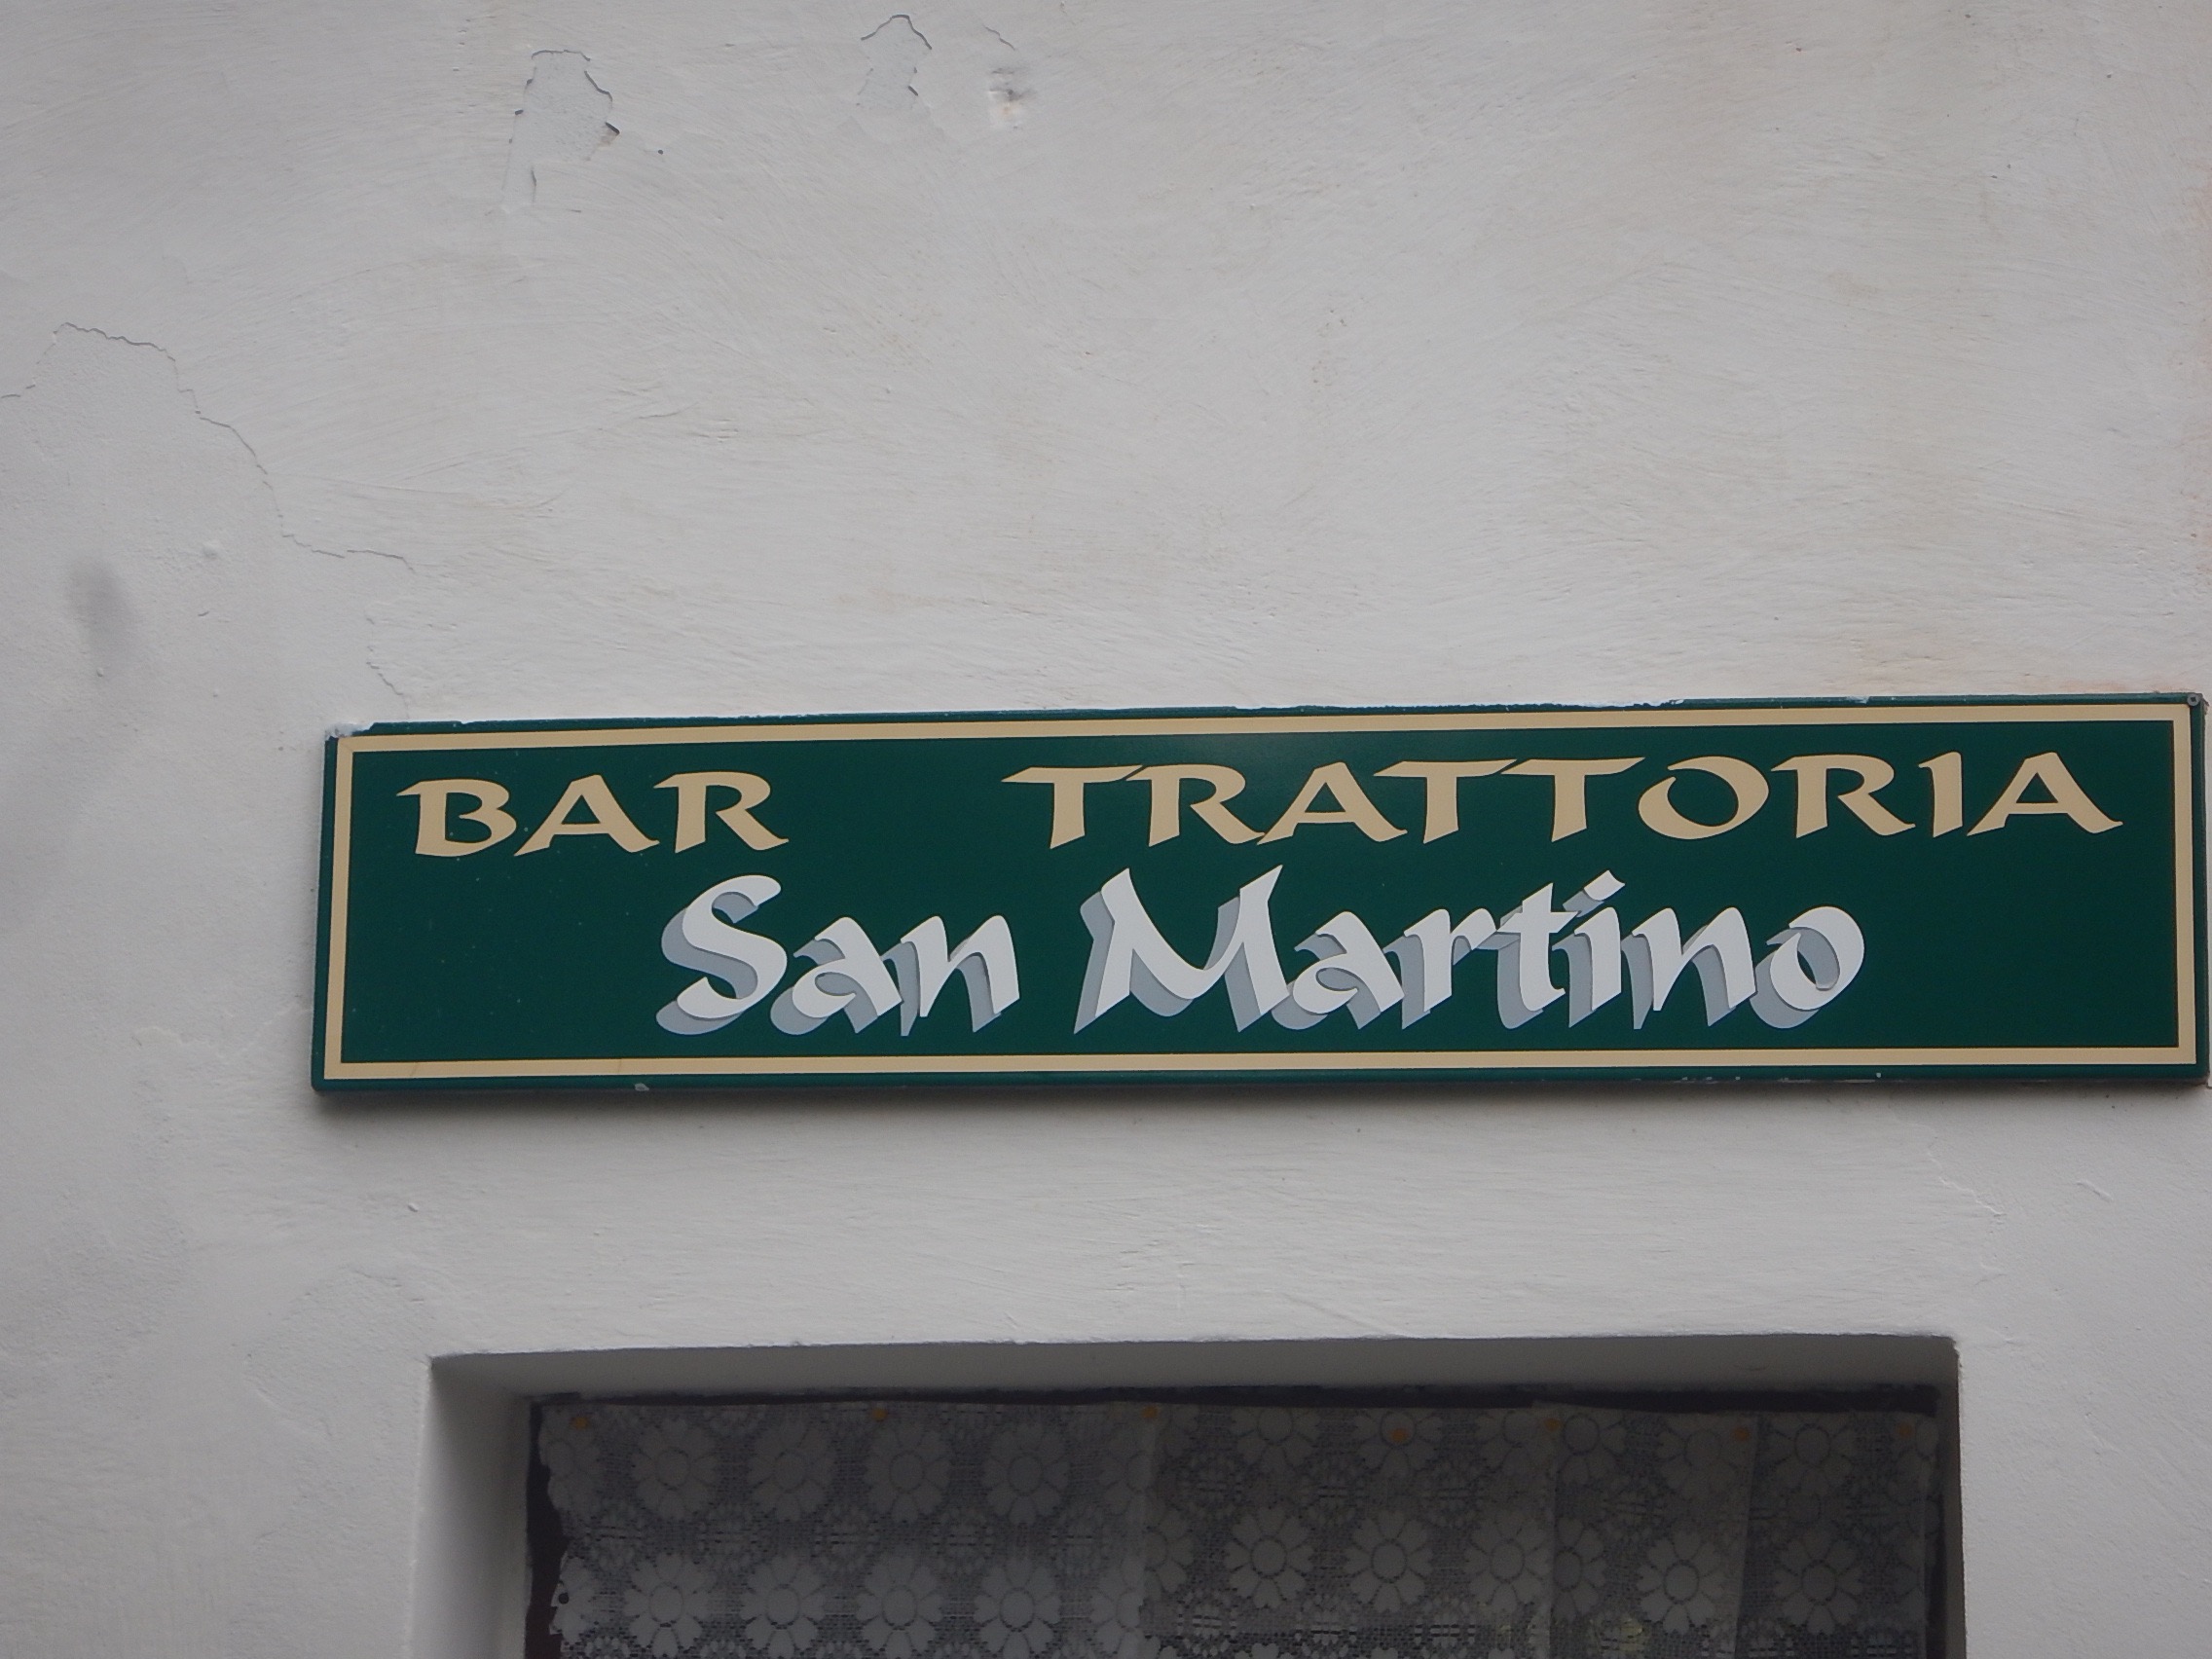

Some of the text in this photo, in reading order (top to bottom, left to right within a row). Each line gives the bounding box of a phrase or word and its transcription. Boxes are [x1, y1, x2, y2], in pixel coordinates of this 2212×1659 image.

[396, 751, 2123, 858] BAR TRATTORIA
[656, 864, 1865, 1036] San Martino
